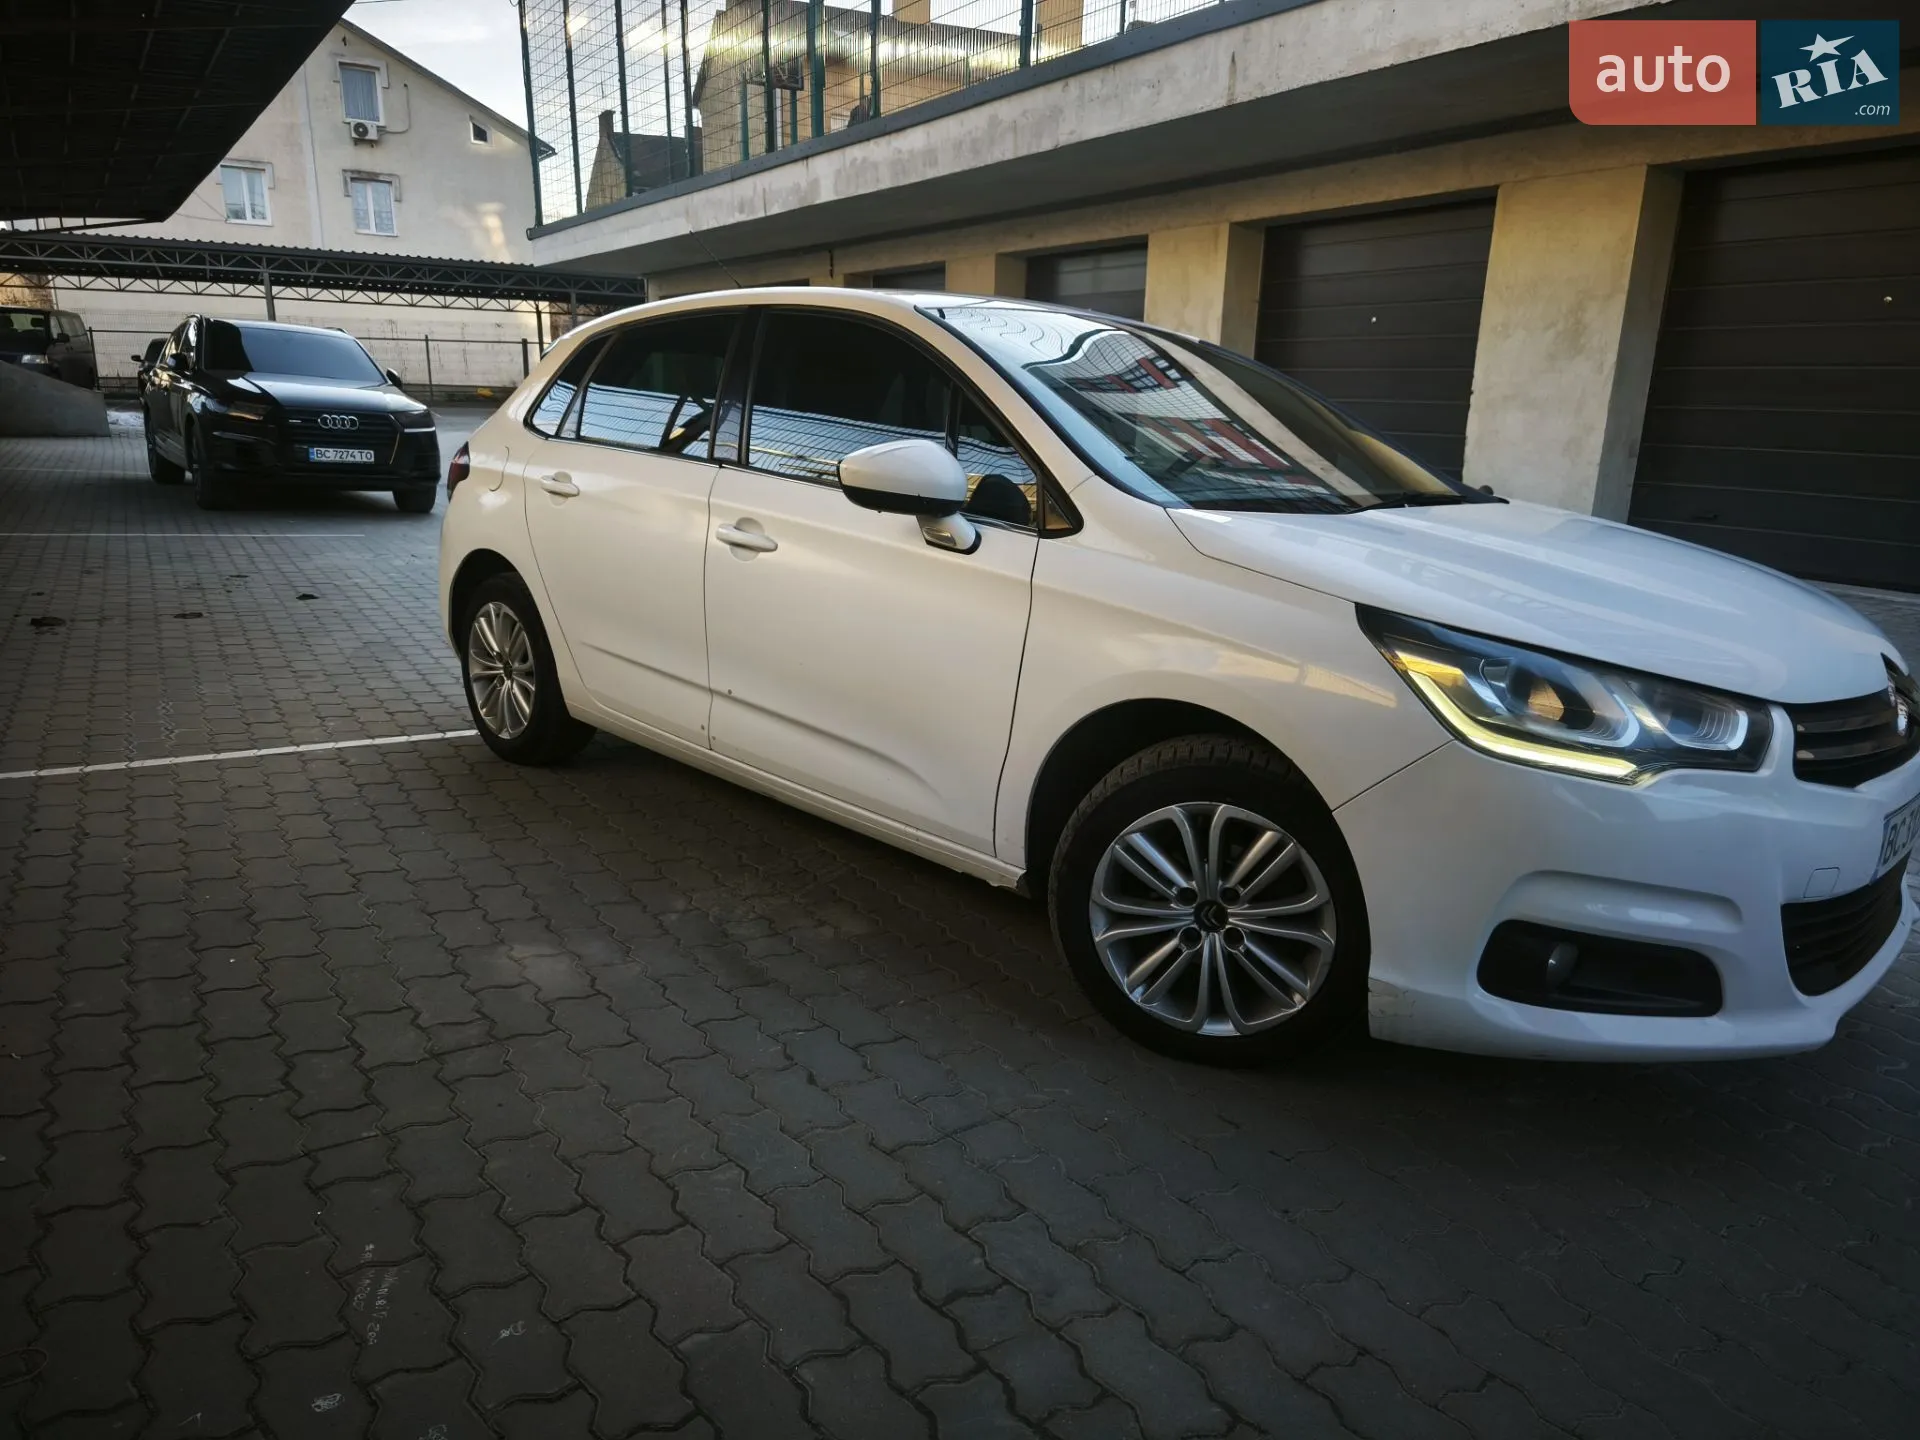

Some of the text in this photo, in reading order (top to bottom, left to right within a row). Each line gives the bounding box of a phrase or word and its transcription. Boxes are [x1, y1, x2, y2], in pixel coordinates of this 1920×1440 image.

[315, 448, 331, 459] BC
[332, 449, 356, 460] 7274
[357, 450, 373, 461] TO
